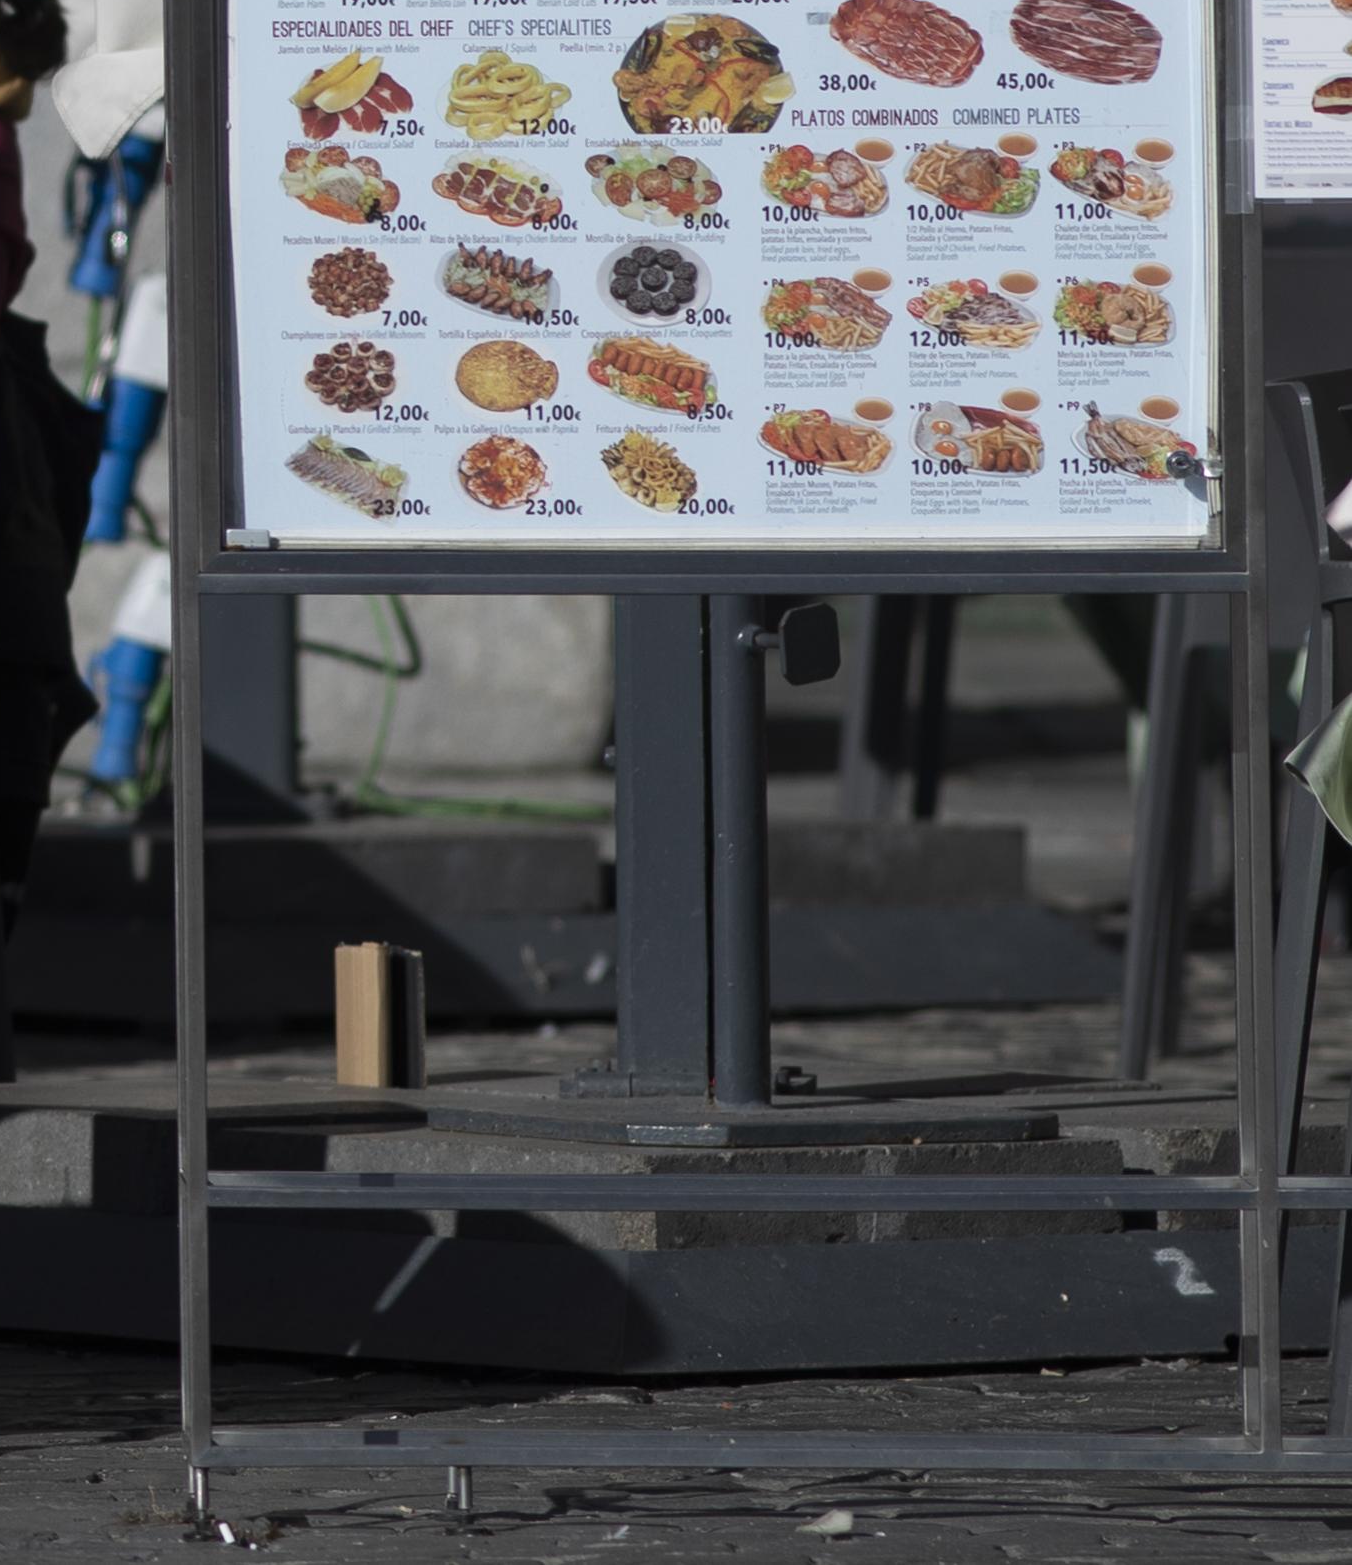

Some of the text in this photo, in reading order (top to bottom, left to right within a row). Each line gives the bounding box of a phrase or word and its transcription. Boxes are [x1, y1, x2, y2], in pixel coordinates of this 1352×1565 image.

[272, 19, 611, 39] ESPECIALIDADES DEL CHEF CHEF'S SPECIALITIES
[819, 74, 876, 91] 38,00€
[996, 72, 1054, 90] 45,00€
[791, 109, 938, 126] PLATOS COMBINADOS
[953, 107, 1080, 125] COMBINED PLATES
[380, 119, 425, 137] 7,50€
[519, 118, 576, 136] 12,00€
[380, 214, 426, 232] 8,00€
[684, 213, 730, 231] 8,00€
[382, 310, 428, 328] 7,00€
[685, 308, 731, 325] 8,00€
[373, 404, 429, 422] 12,00€
[524, 404, 580, 421] 11,00€
[525, 499, 582, 516] 23,00€
[678, 498, 734, 516] 20,00€
